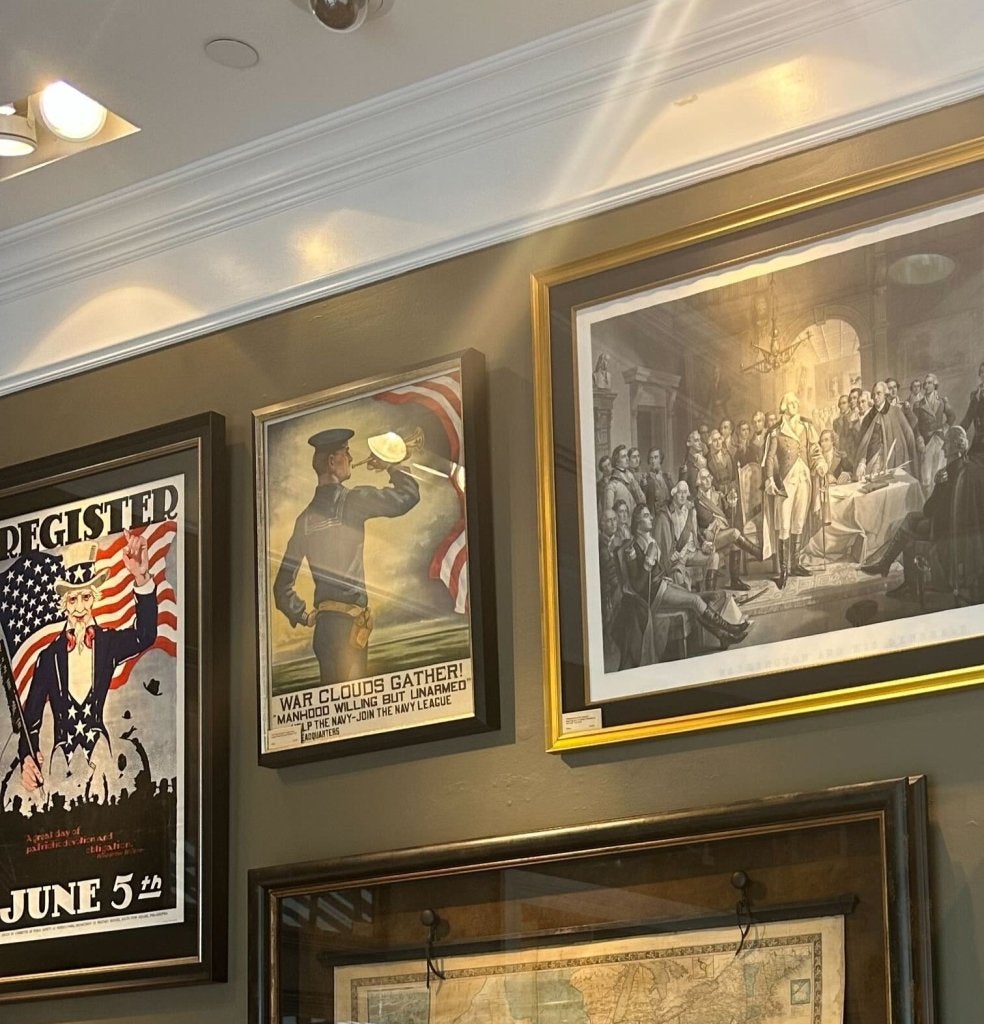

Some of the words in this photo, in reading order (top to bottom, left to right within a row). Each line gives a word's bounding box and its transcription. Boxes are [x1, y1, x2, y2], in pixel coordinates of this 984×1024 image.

[0, 485, 179, 562] REGISTER
[280, 691, 313, 711] WAR
[319, 678, 385, 704] CLOUDS
[390, 662, 463, 690] GATHER!
[335, 695, 378, 713] WILLING
[383, 691, 406, 705] BUT
[314, 717, 330, 729] THE
[377, 703, 393, 718] THE
[394, 701, 416, 715] NAVY
[417, 695, 452, 711] LEAGUE
[0, 878, 100, 924] JUNE
[110, 872, 162, 910] 5th
